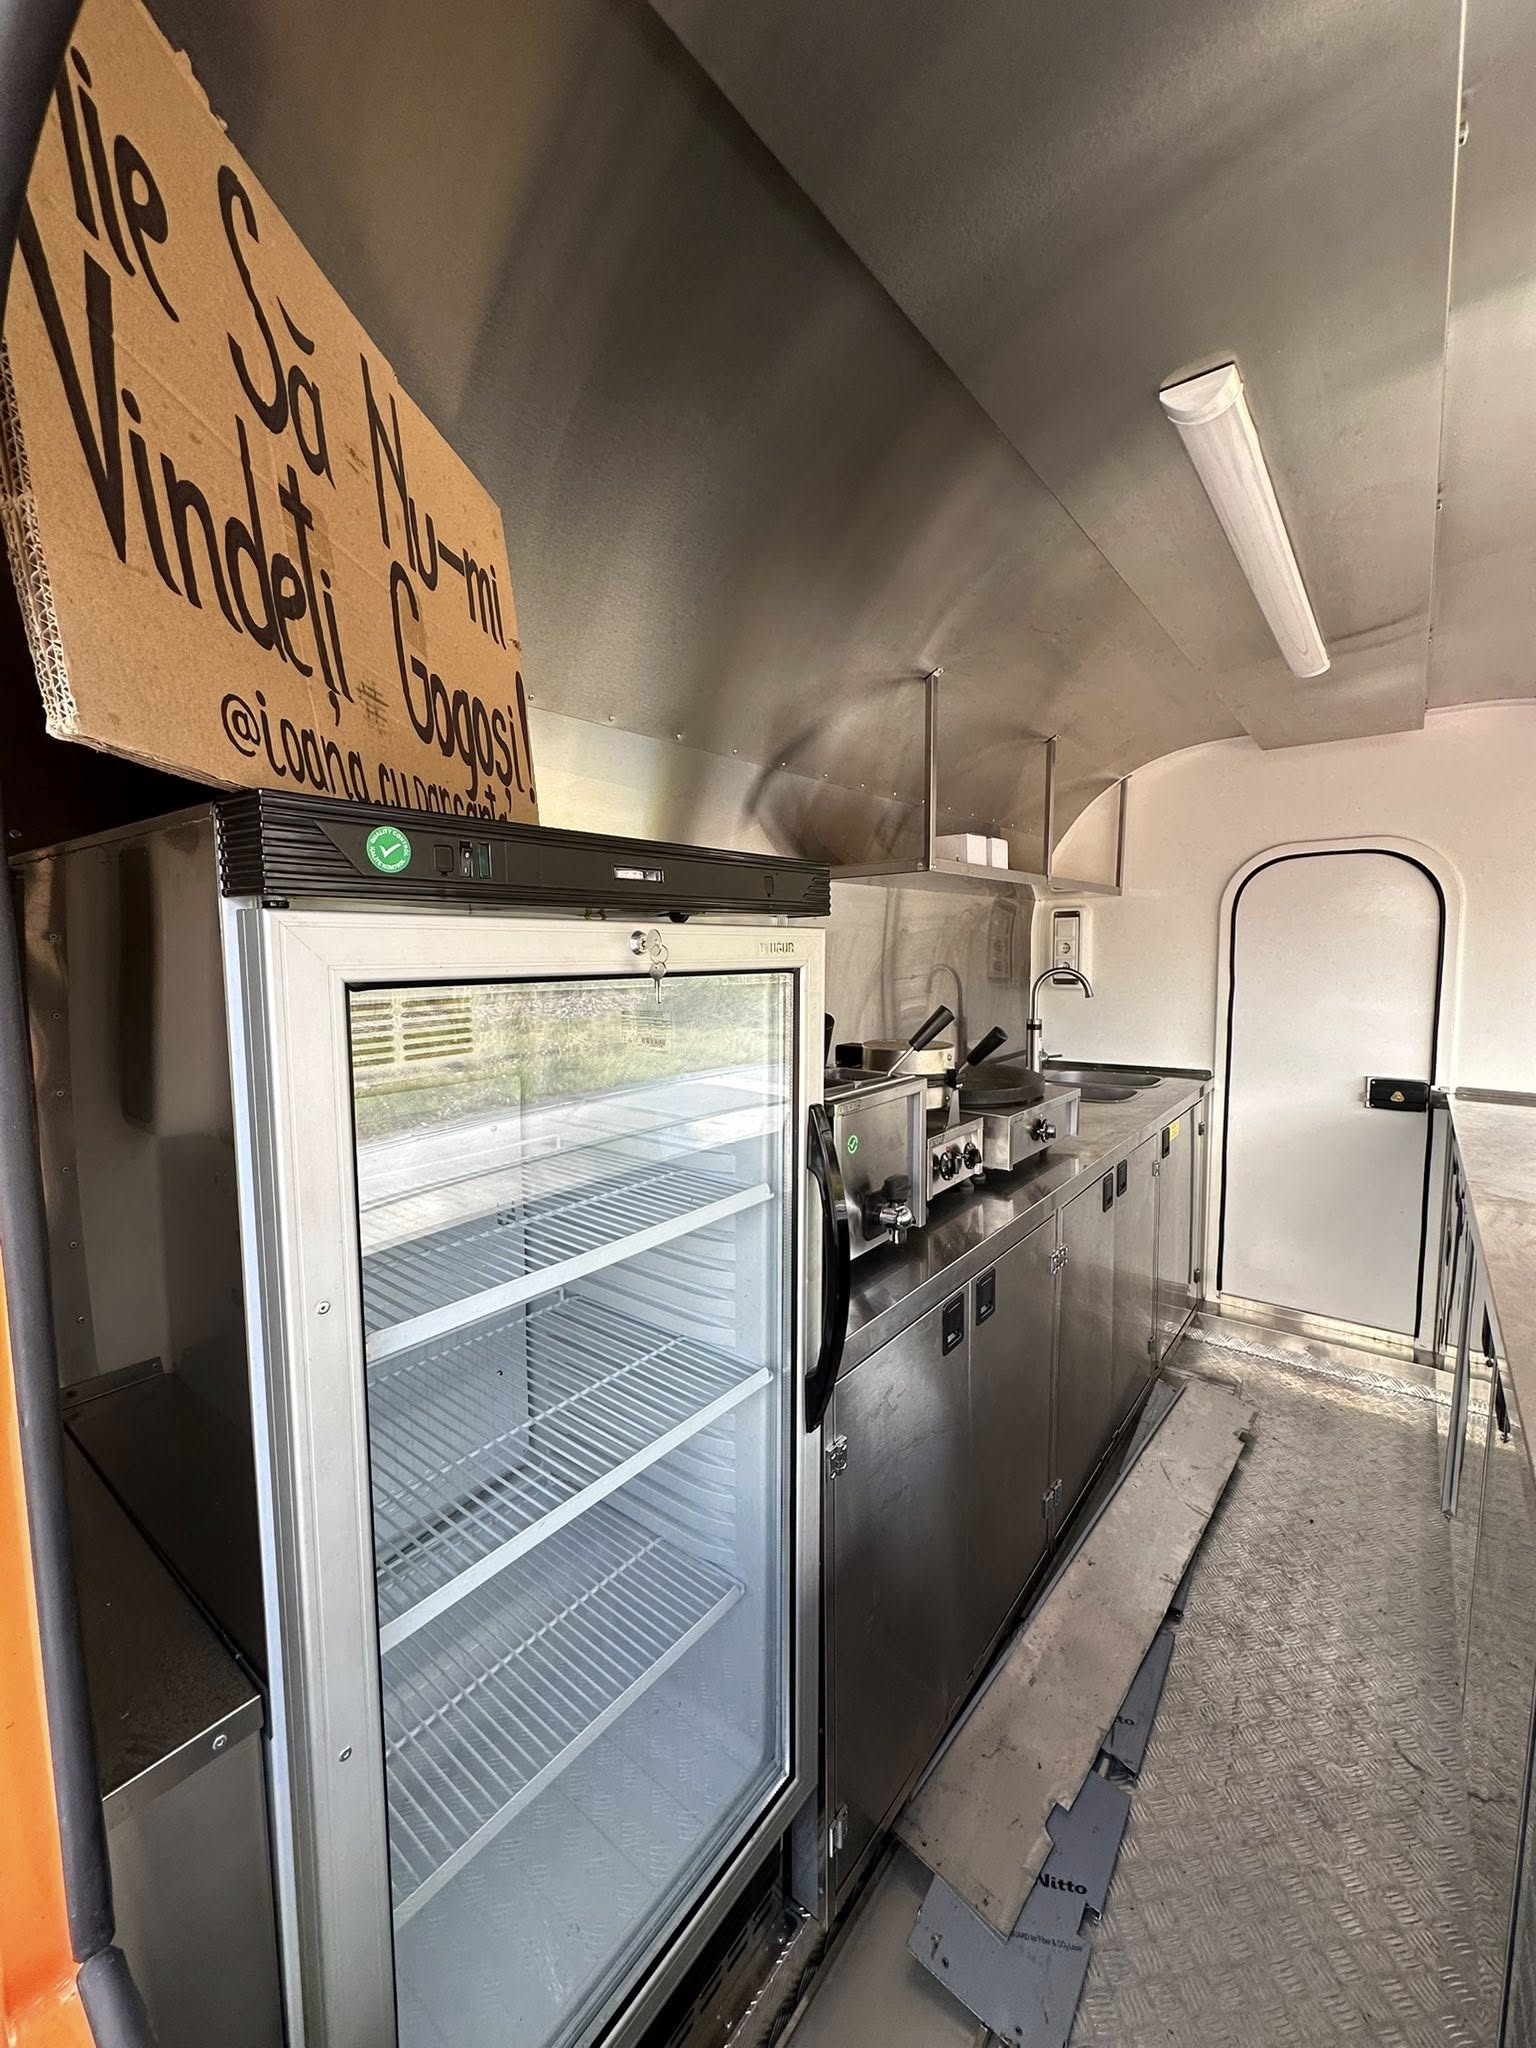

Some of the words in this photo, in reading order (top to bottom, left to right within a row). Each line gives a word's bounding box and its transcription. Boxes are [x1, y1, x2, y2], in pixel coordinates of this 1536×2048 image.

[17, 200, 354, 726] Vindeți
[54, 46, 180, 323] lie
[217, 165, 335, 490] Să
[359, 353, 507, 651] Nu-mi
[370, 828, 392, 844] QUALITY
[392, 830, 409, 857] CONTROL
[1034, 1872, 1088, 1896] Nitto
